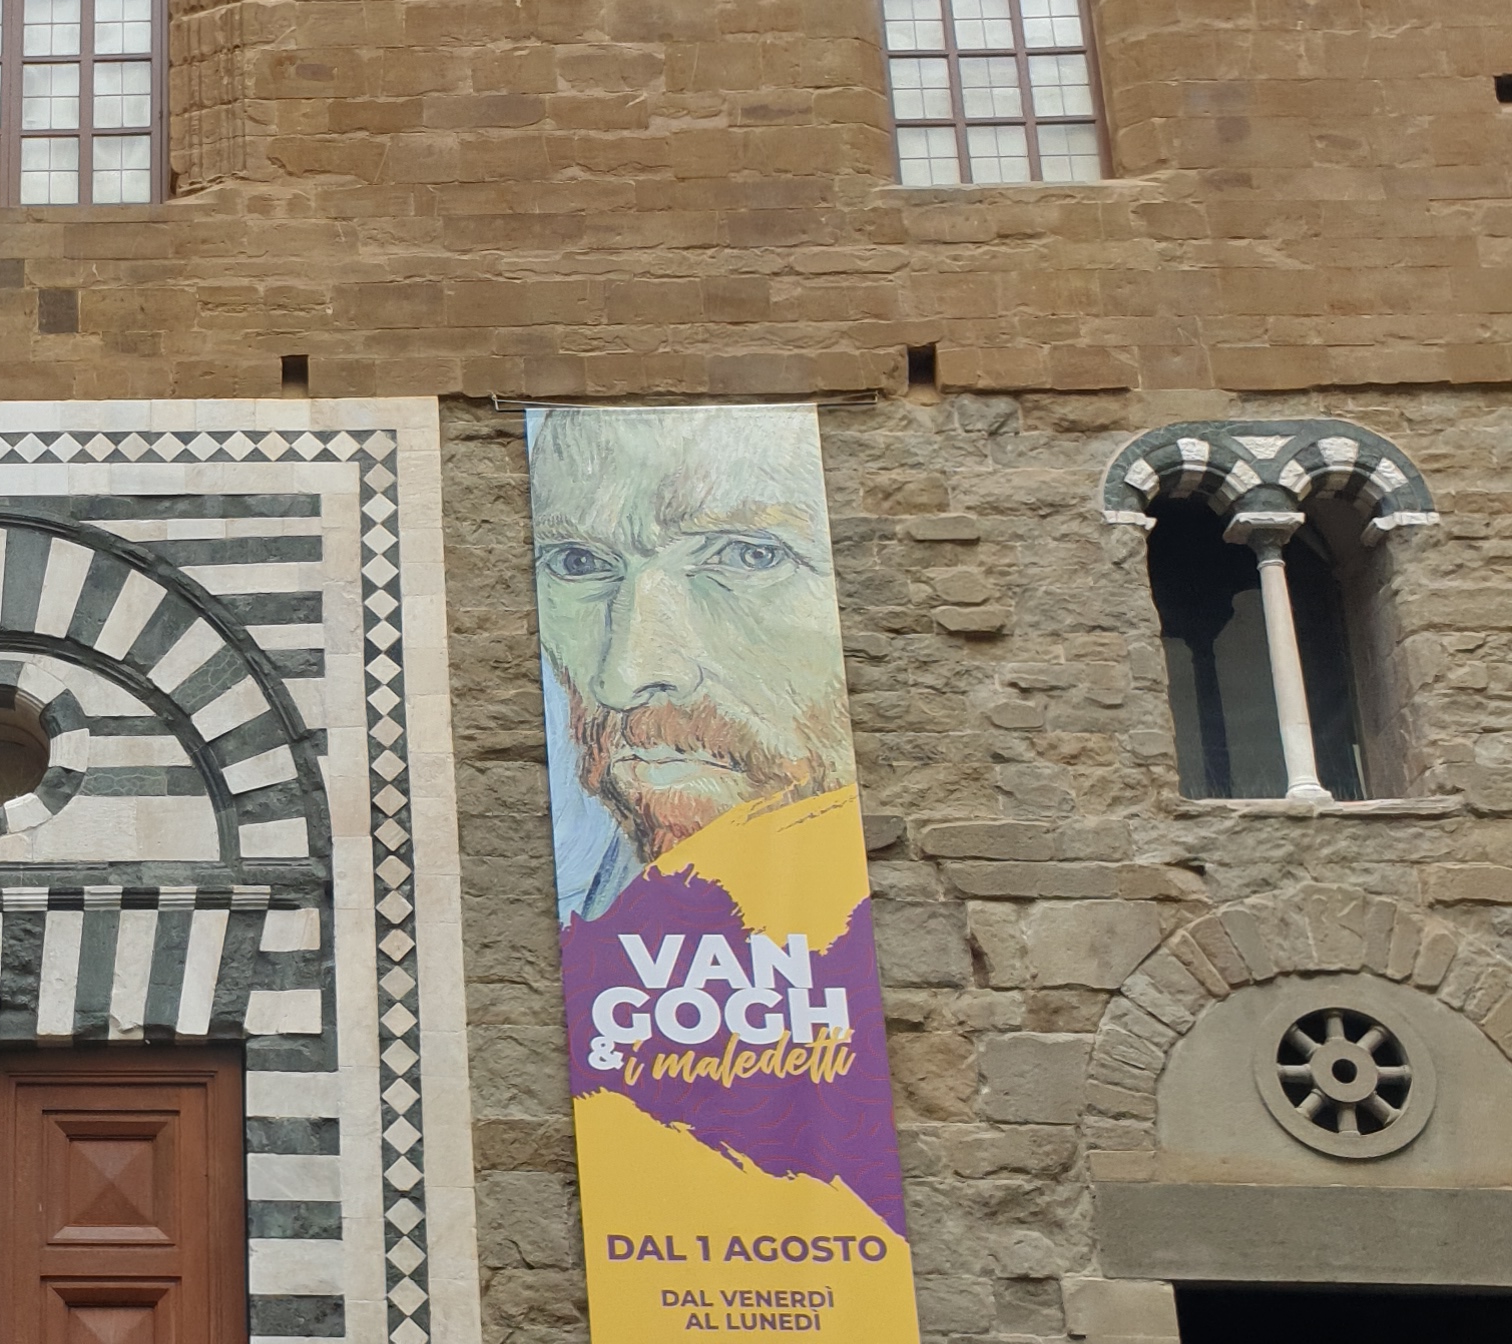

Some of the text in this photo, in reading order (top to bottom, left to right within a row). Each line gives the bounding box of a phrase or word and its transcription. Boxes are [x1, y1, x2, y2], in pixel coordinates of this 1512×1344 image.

[617, 933, 813, 989] VAN
[591, 986, 852, 1045] GOGH
[588, 1027, 856, 1088] & i maledetti
[606, 1234, 888, 1262] DAL 1 AGOSTO
[661, 1285, 835, 1308] DAL VENERDÌ
[685, 1309, 821, 1331] AL LUNEDÌ
